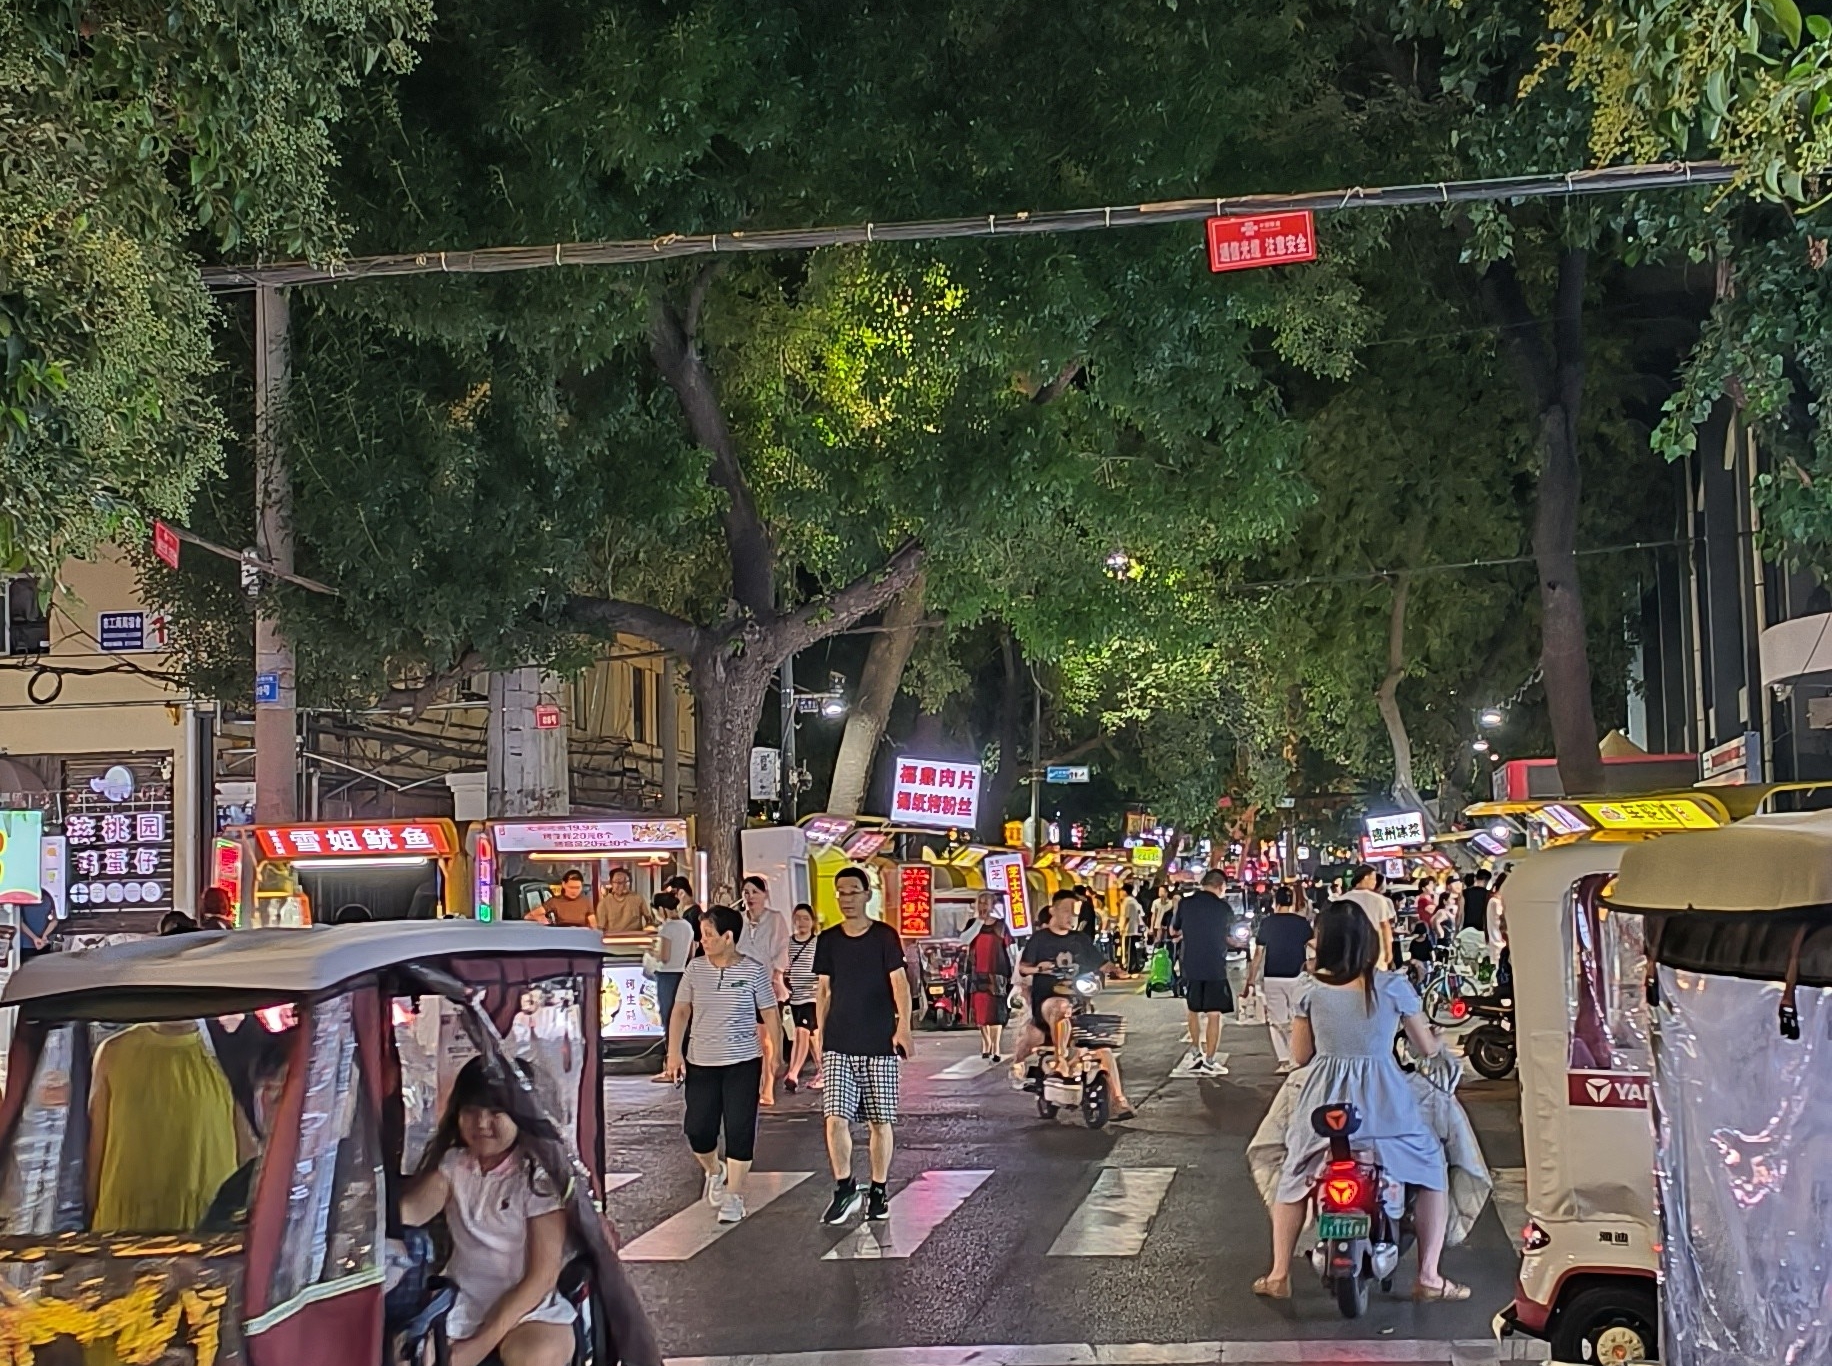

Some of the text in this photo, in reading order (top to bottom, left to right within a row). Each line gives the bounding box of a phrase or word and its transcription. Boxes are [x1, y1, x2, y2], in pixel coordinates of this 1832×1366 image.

[1265, 233, 1307, 256] 注意安全
[289, 827, 434, 852] 雪姐鱿鱼
[77, 848, 160, 876] 鸡蛋仔
